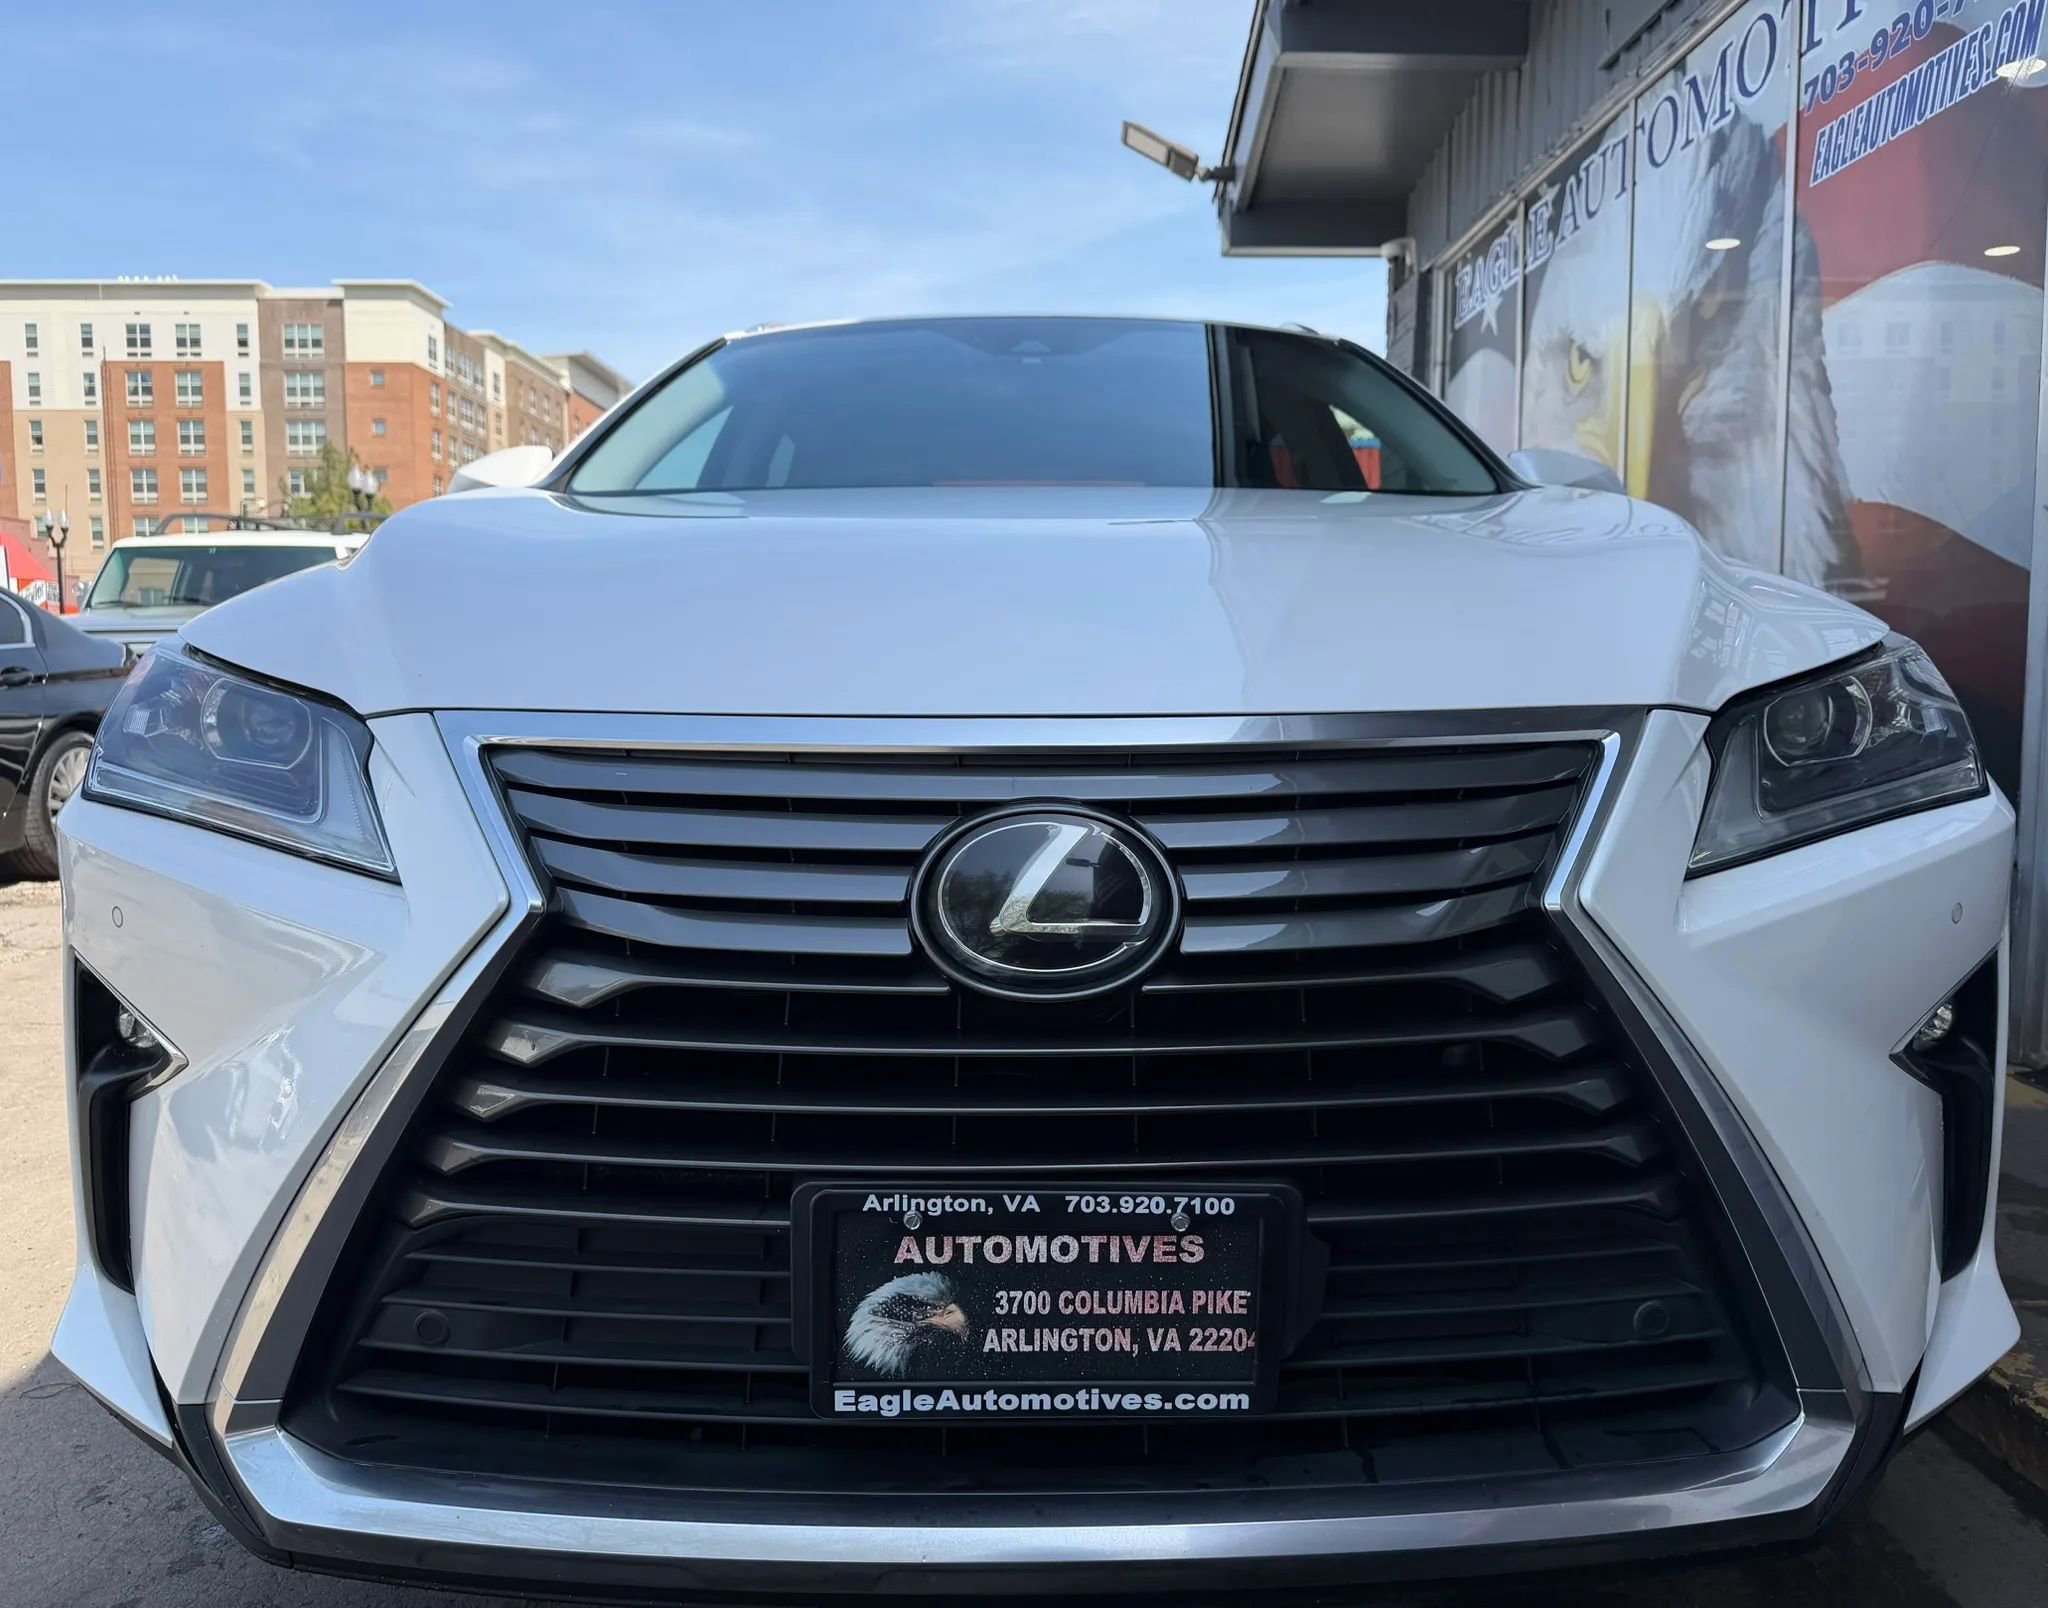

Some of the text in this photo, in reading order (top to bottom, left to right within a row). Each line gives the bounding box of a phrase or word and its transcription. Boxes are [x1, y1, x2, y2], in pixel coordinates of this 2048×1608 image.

[1809, 0, 2048, 187] EAGLEAUTOMOTIVES.COM
[1455, 197, 1555, 330] EAGLE
[863, 1194, 1236, 1217] Arlington, VA 703.920.7100
[894, 1234, 1205, 1265] AUTOMOTIVES
[995, 1290, 1249, 1315] 3700 COLUMBIA PIKE
[983, 1327, 1139, 1357] ARLINGTON,
[1146, 1328, 1182, 1352] VA
[834, 1389, 1250, 1417] EagleAutomotives.com
